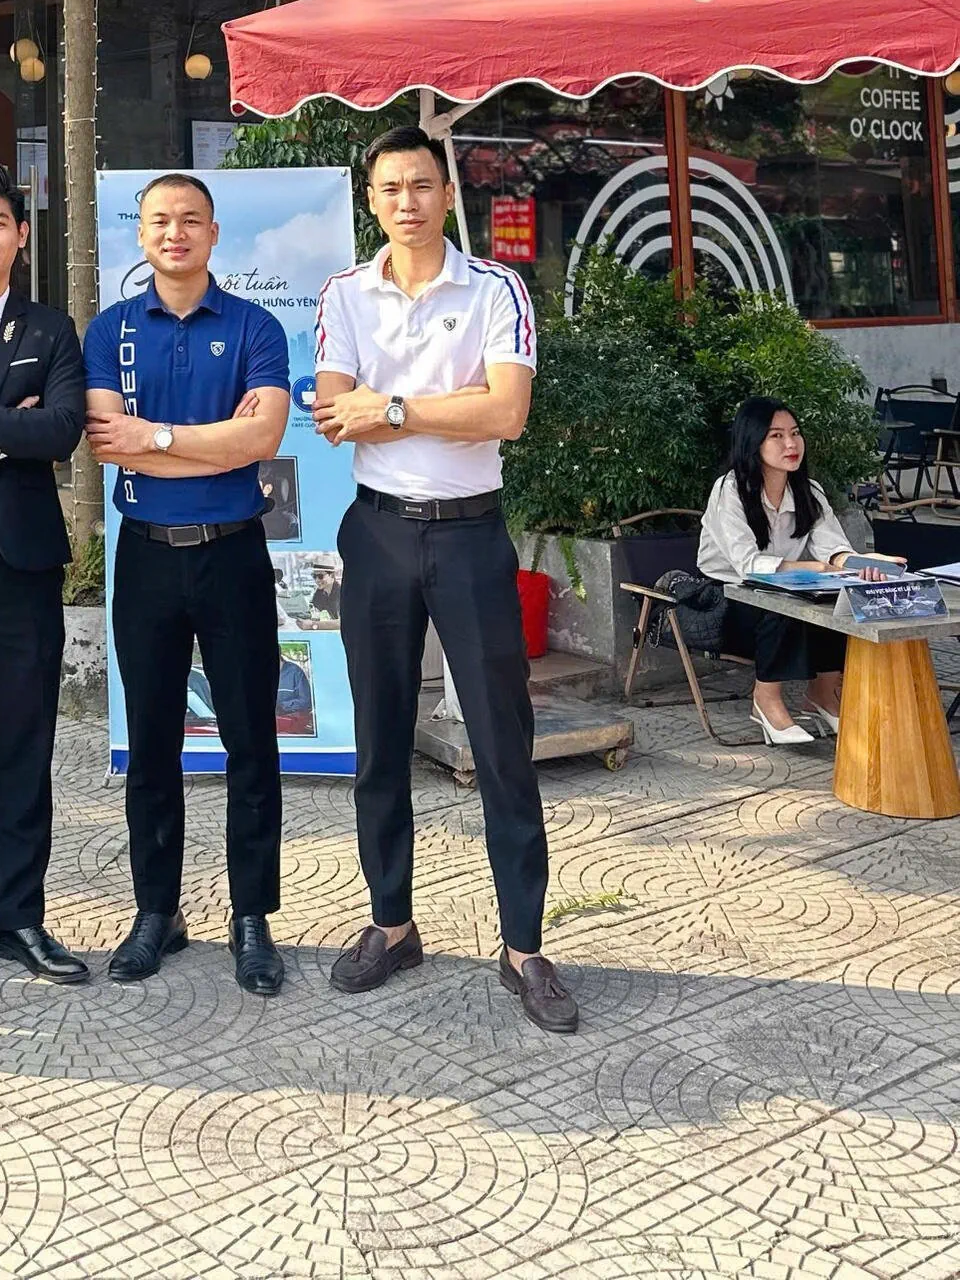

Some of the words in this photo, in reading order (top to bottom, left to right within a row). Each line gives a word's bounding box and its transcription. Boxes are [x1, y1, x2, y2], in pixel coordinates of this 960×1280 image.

[860, 87, 921, 111] COFFEE
[242, 267, 289, 291] tuần
[262, 296, 295, 308] HƯNG
[295, 296, 317, 308] YÊN
[119, 319, 138, 504] PGEOT
